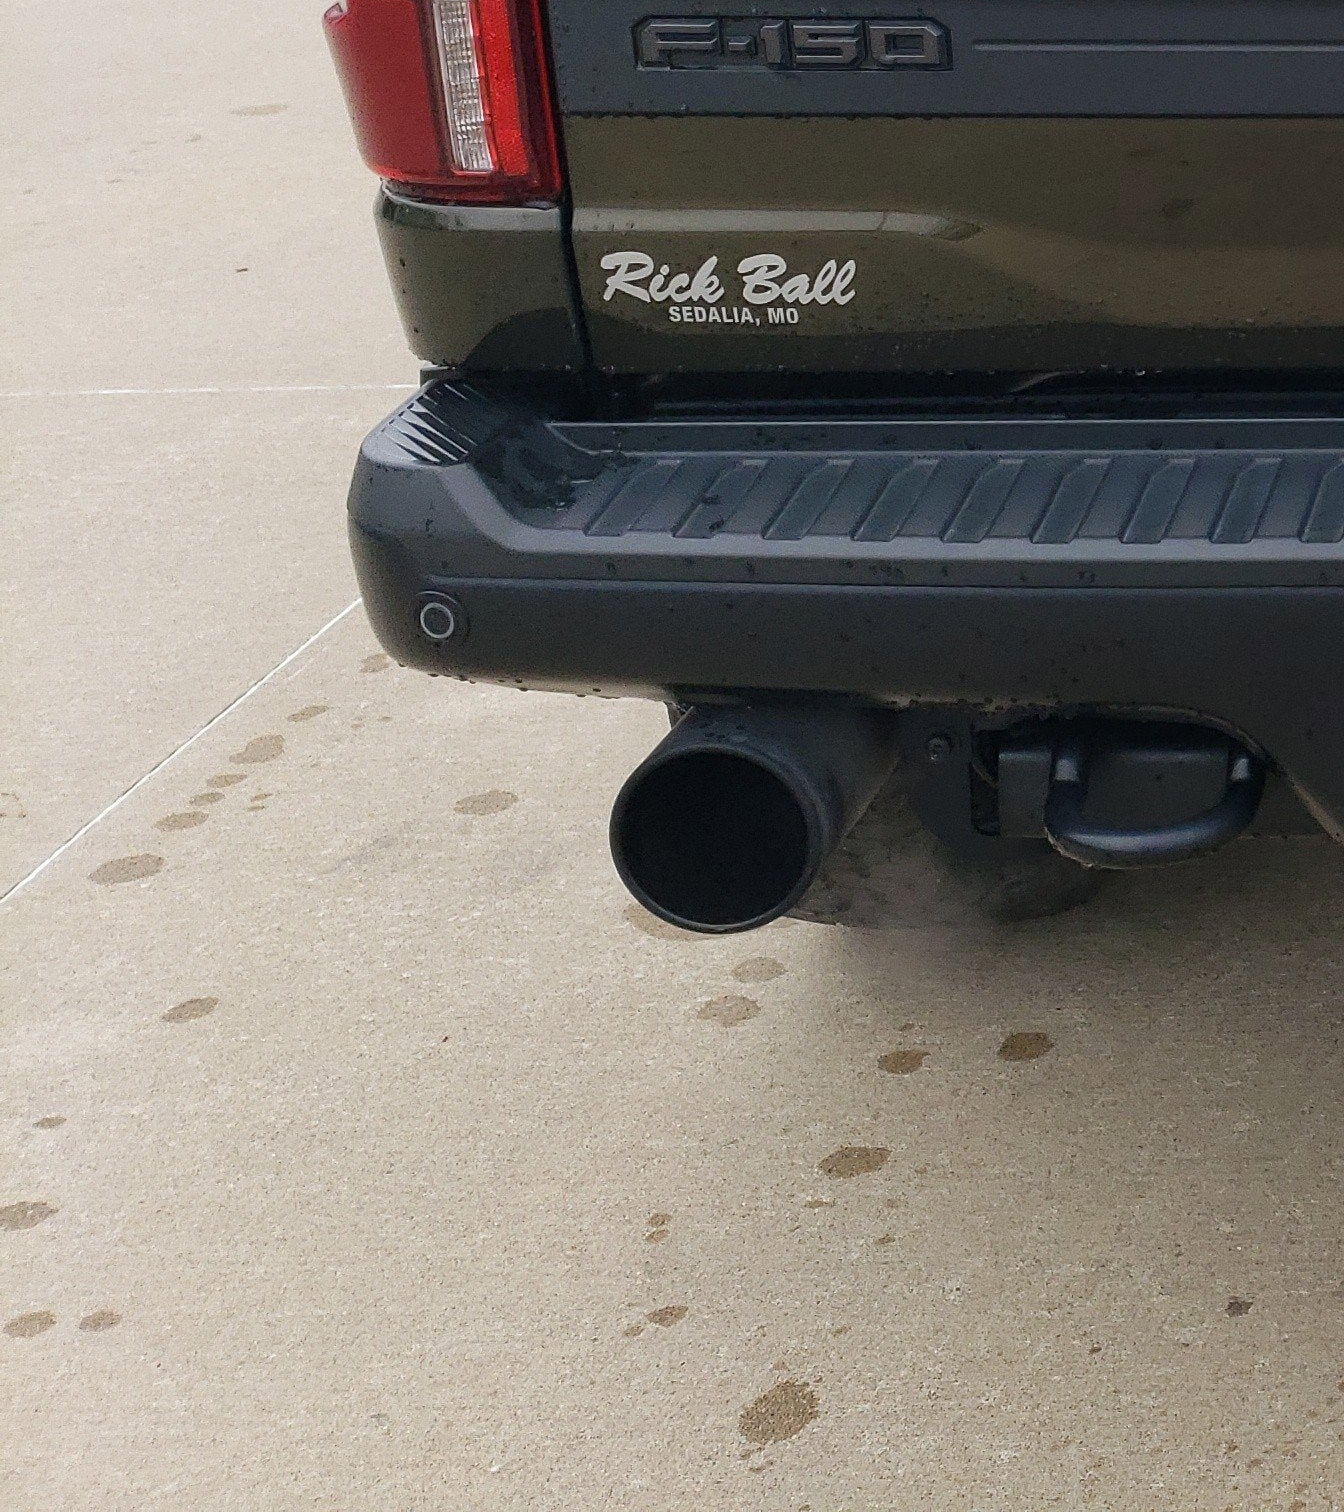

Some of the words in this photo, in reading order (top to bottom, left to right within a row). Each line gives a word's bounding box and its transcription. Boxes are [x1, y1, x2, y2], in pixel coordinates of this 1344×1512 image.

[635, 16, 953, 70] F-150
[600, 251, 724, 304] Rick
[737, 253, 856, 306] Ball
[668, 305, 760, 326] SEDALIA,
[767, 307, 799, 324] MO
